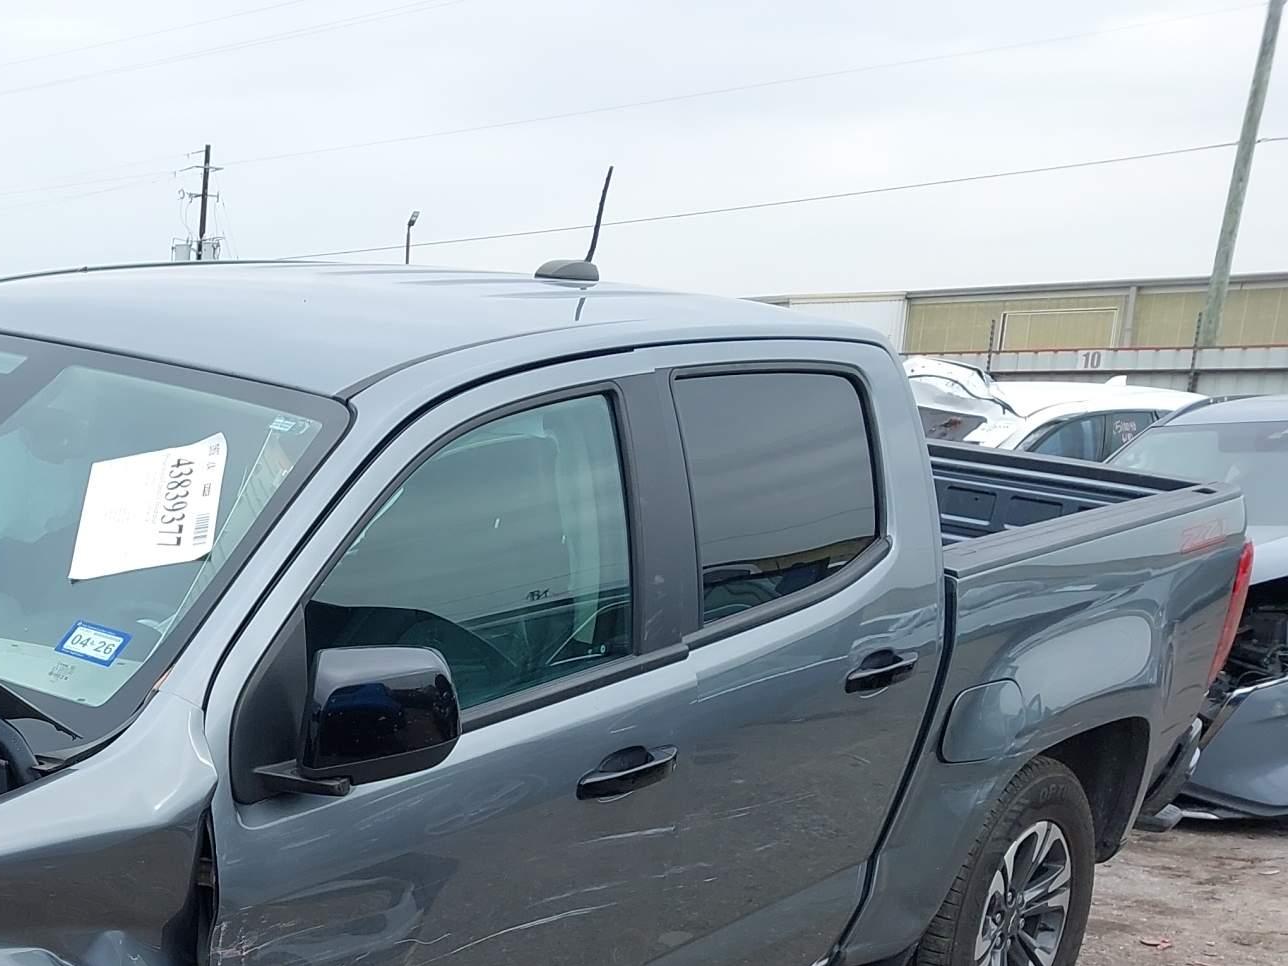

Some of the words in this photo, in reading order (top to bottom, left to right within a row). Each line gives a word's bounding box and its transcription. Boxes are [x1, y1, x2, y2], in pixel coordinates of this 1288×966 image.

[1081, 351, 1102, 369] 10
[156, 458, 195, 546] 43839377
[71, 633, 91, 648] 04
[94, 640, 116, 655] 26
